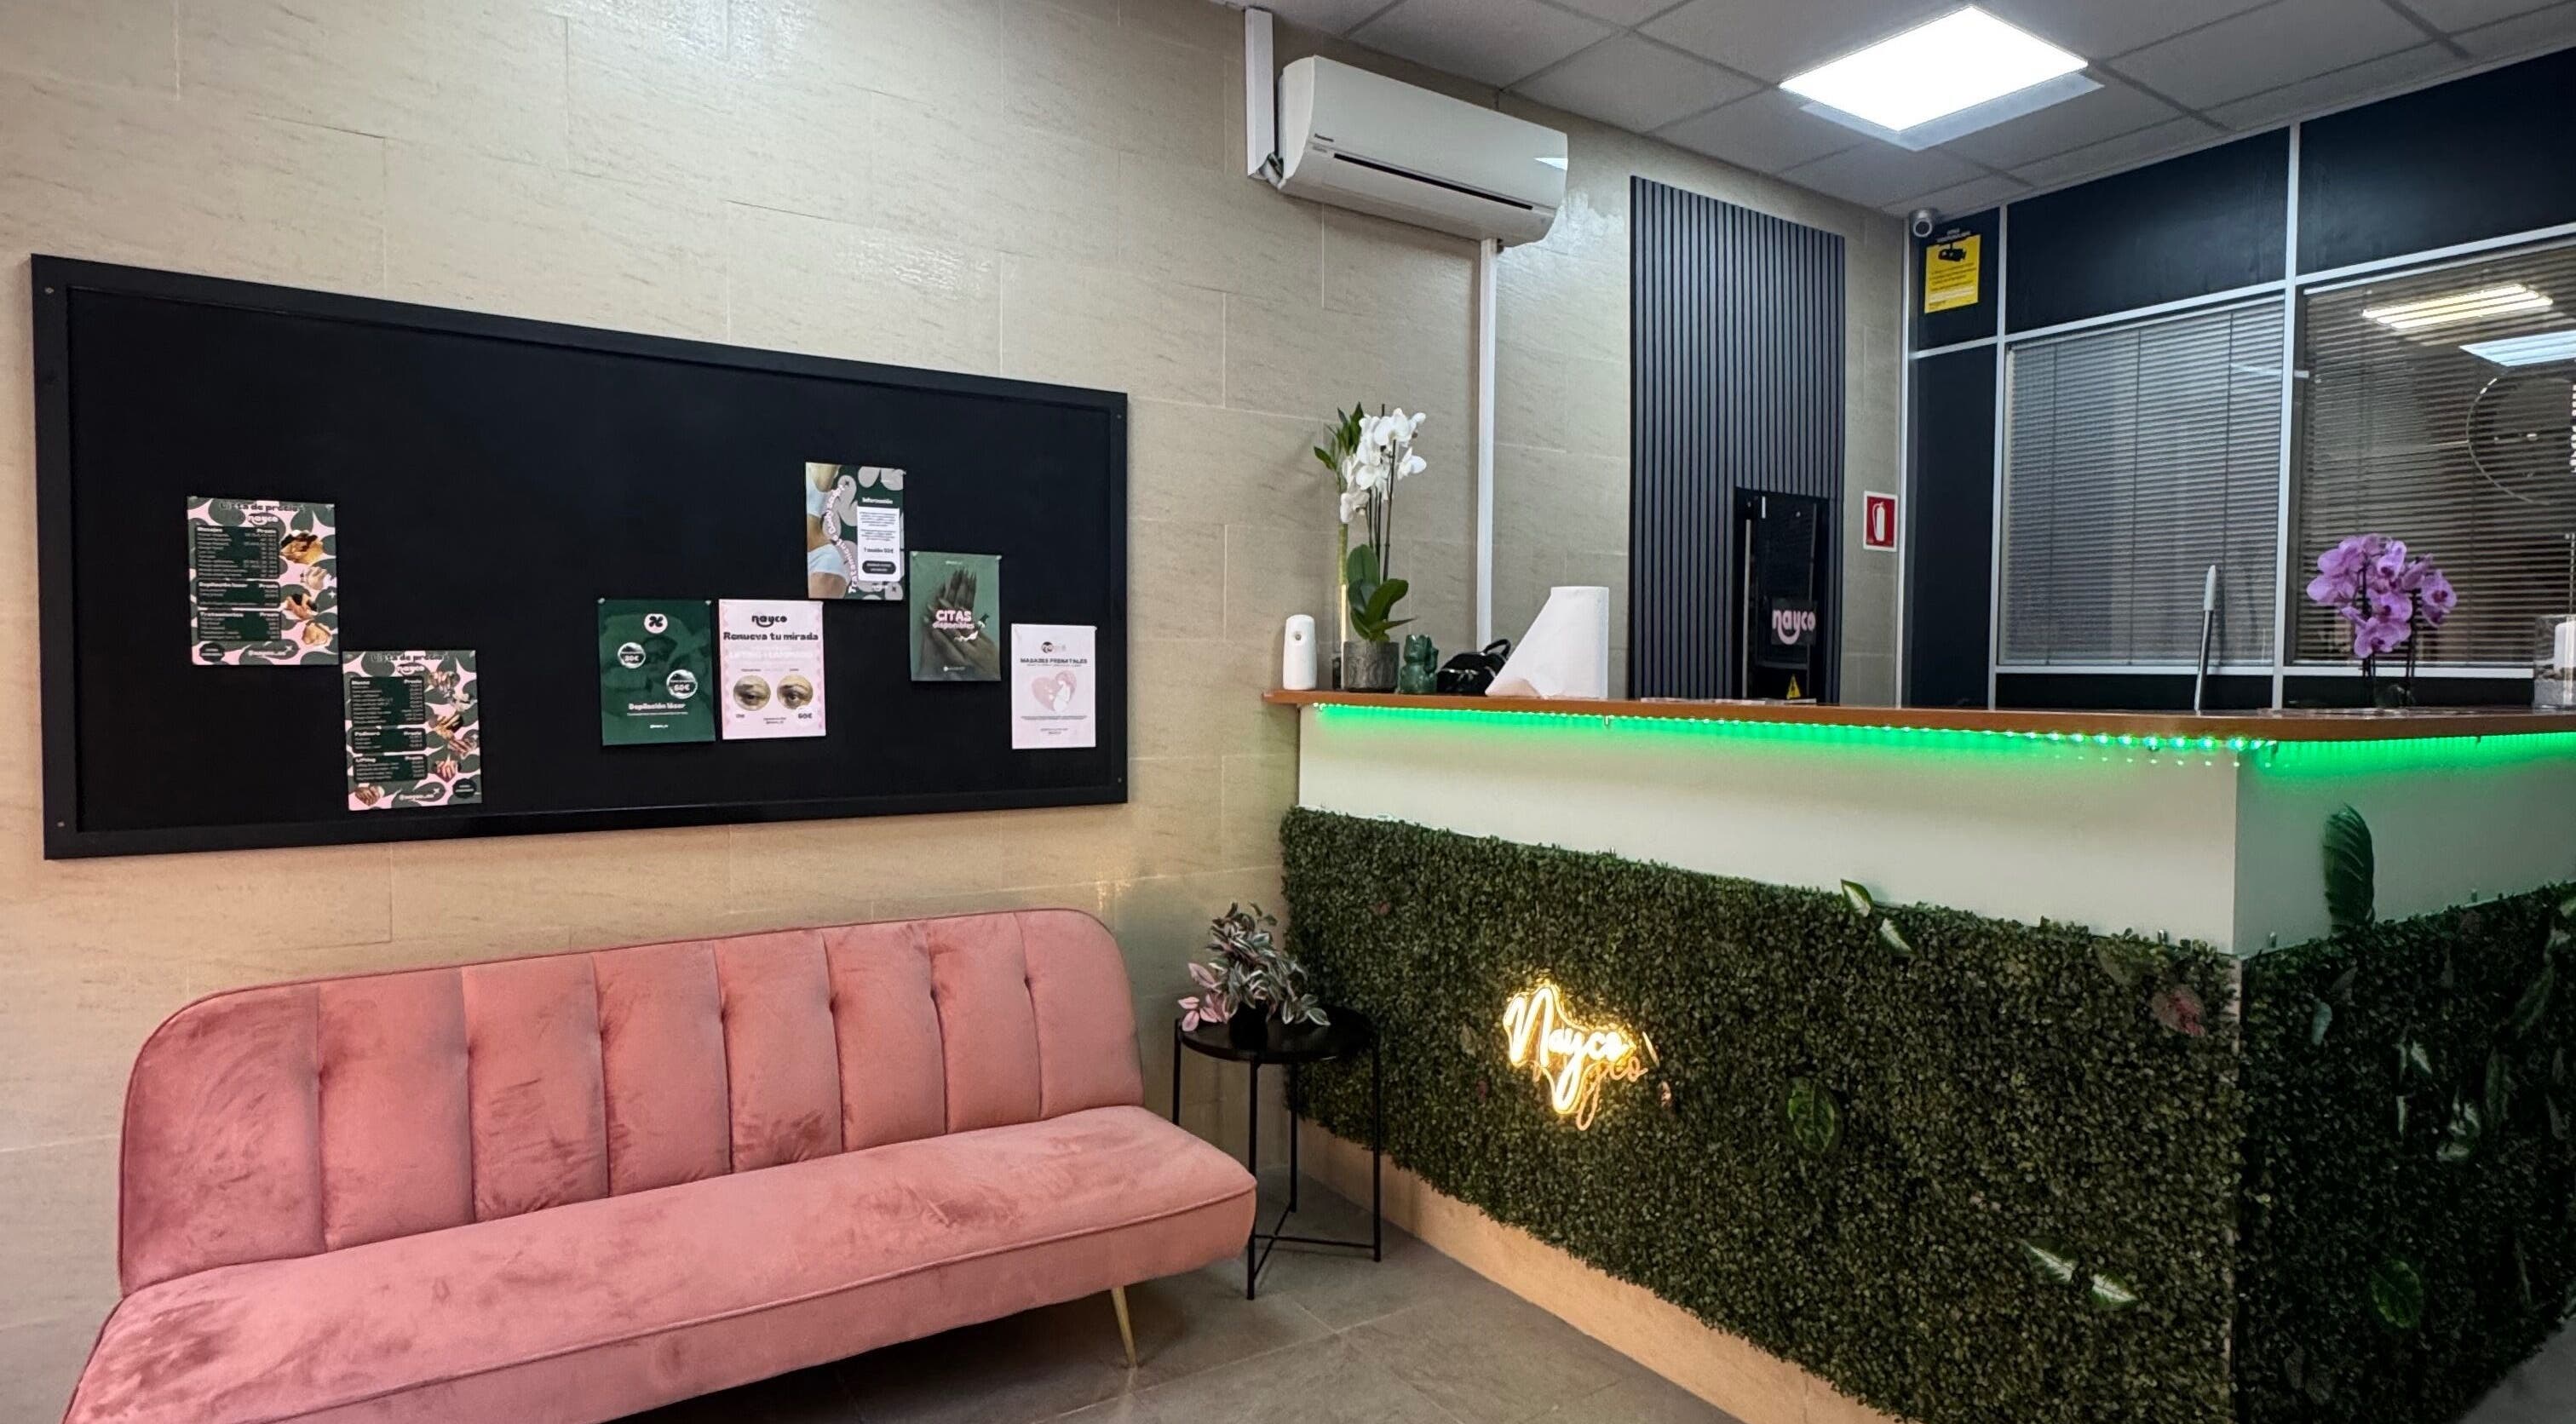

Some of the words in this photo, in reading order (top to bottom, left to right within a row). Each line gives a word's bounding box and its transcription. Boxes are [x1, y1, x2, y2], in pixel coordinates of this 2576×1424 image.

[751, 615, 788, 629] nayco
[935, 610, 972, 622] CITAS
[1771, 608, 1816, 646] nayco
[769, 632, 782, 641] tu
[783, 631, 819, 641] mirada
[1503, 986, 1630, 1111] Nayco
